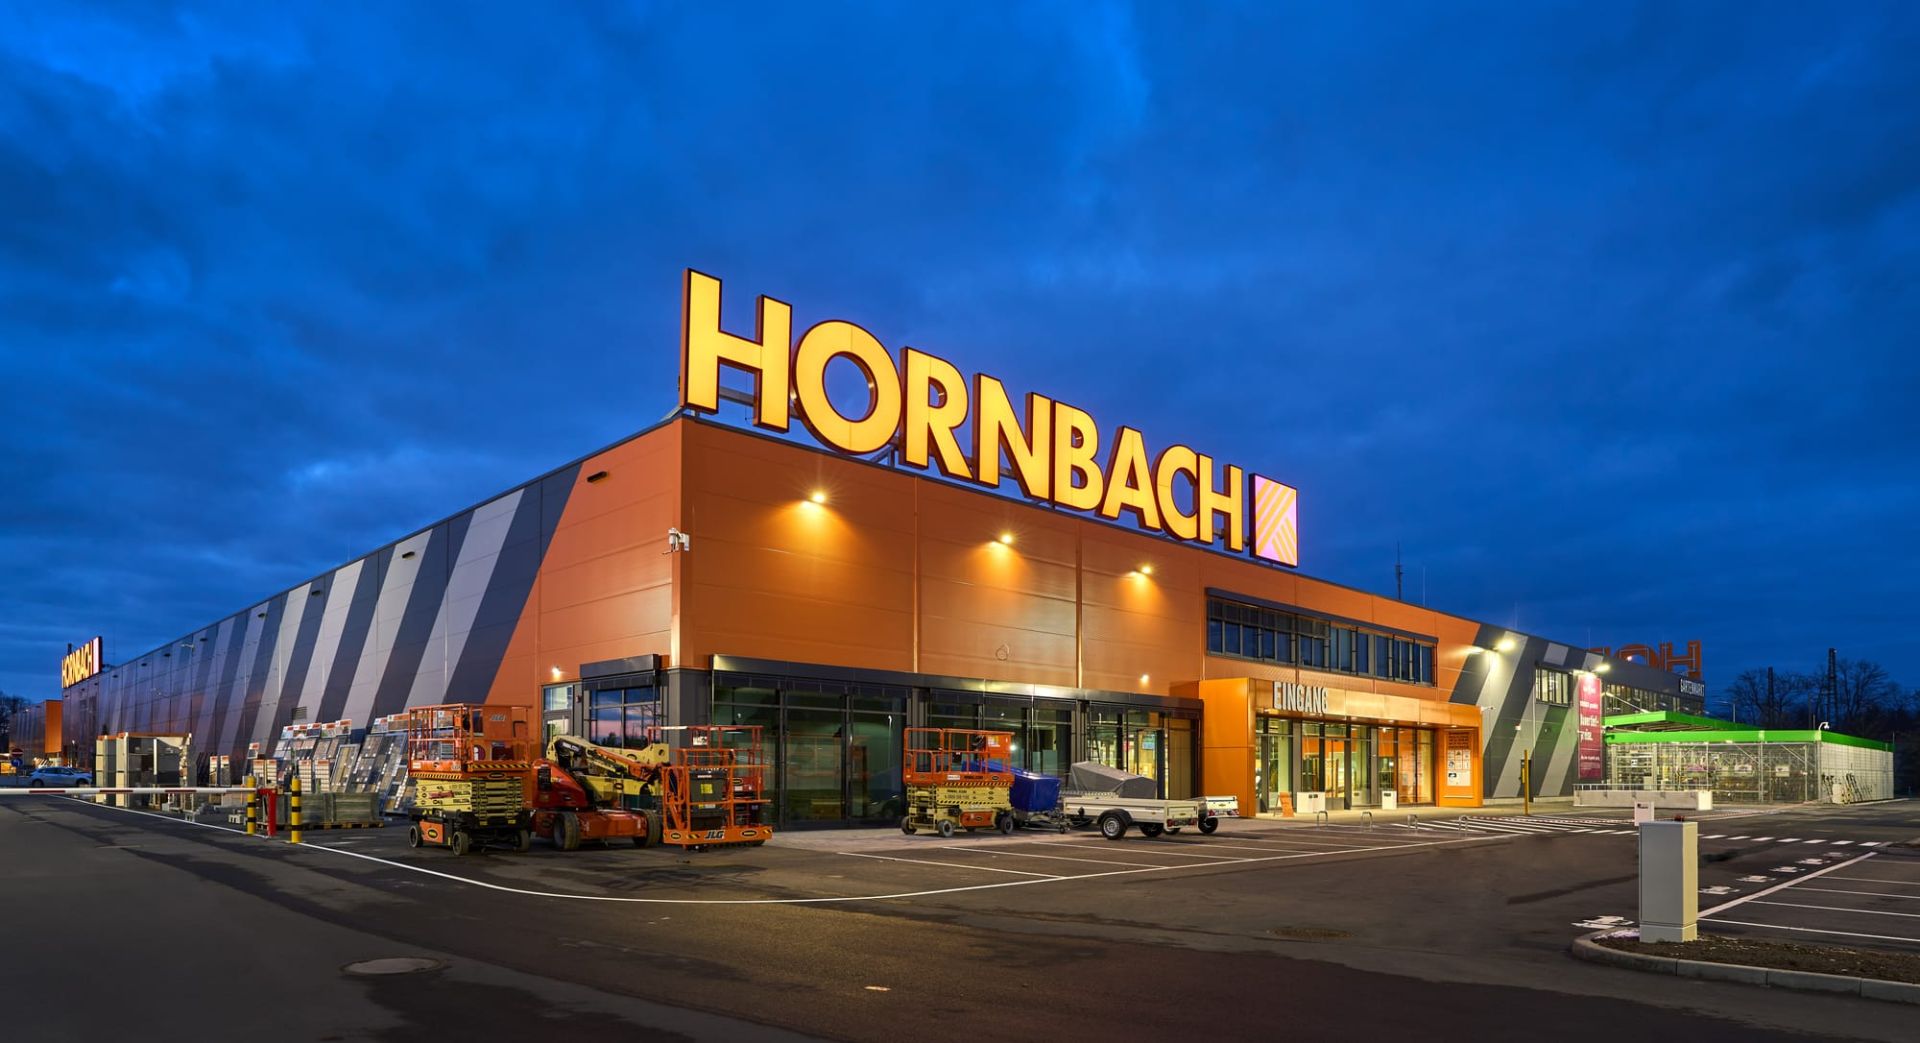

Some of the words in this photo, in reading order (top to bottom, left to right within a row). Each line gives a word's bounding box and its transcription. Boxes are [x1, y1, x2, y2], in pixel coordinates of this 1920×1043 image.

[682, 268, 1244, 552] HORNBACH
[62, 639, 93, 689] HORNBACH
[1272, 681, 1329, 714] EINGANG
[704, 830, 725, 840] JLG
